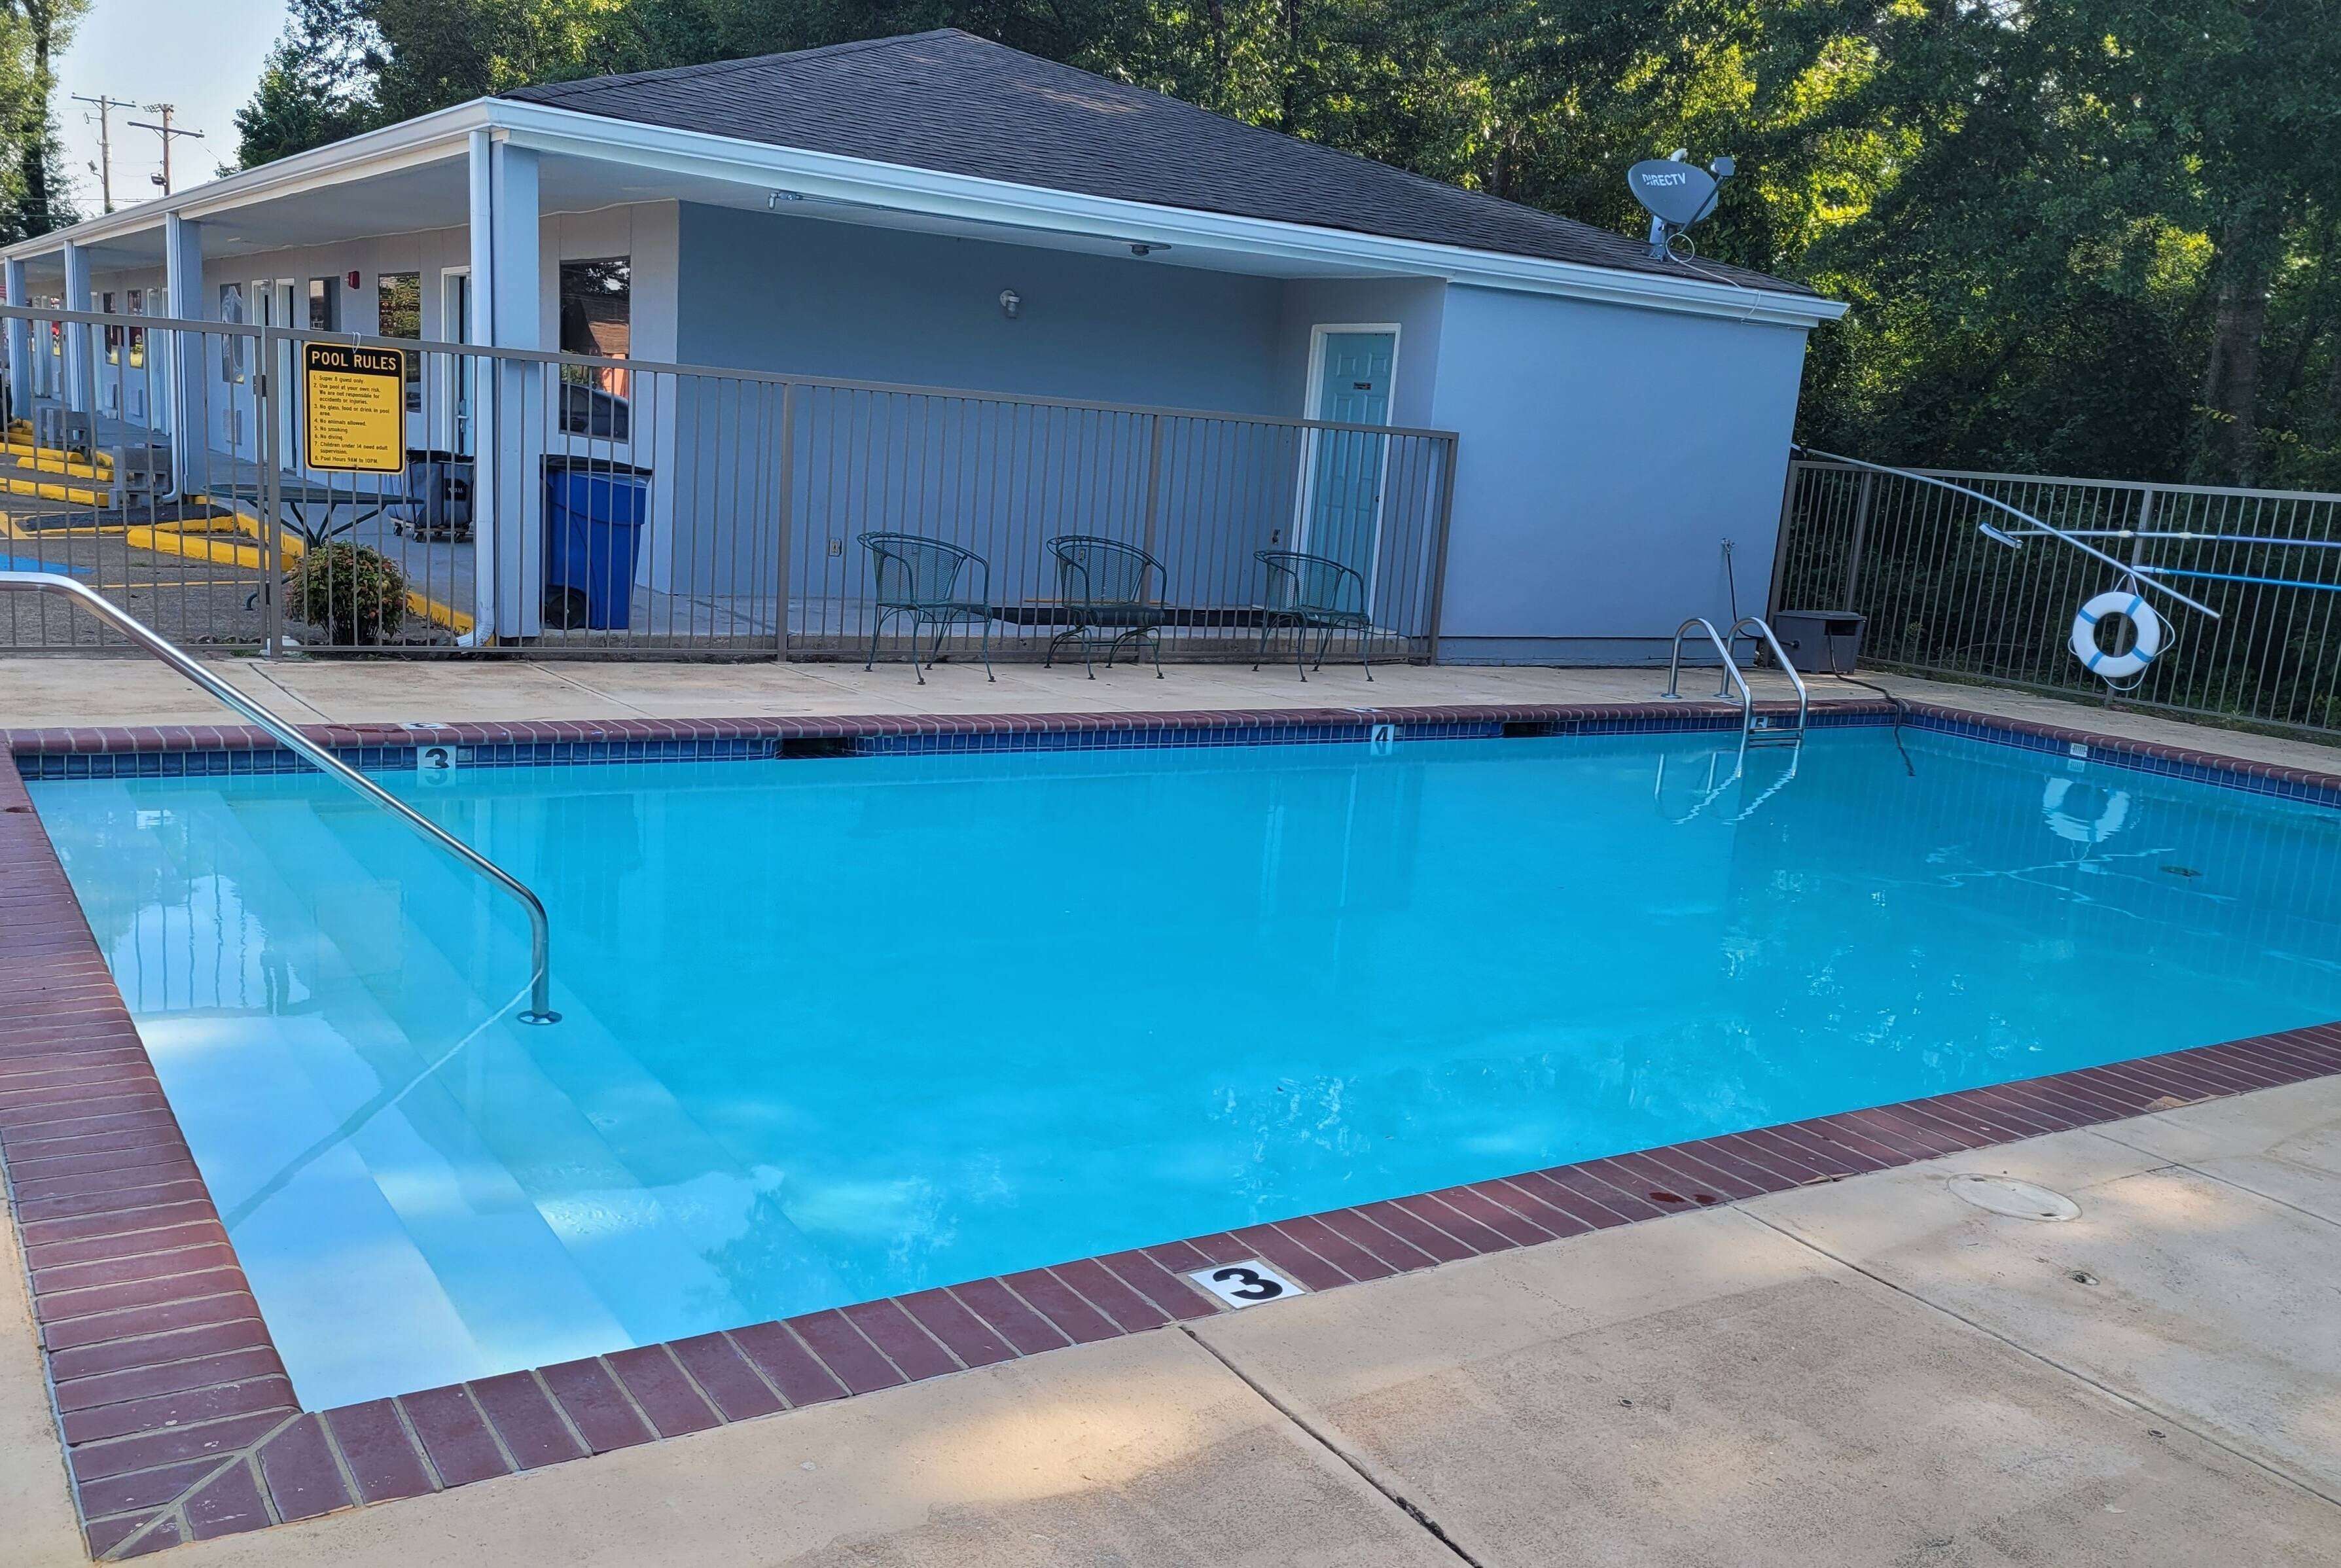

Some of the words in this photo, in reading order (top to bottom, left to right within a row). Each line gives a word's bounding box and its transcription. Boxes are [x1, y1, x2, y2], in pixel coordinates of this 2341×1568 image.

[1641, 172, 1686, 187] DIRECTV
[312, 350, 349, 367] POOL
[353, 354, 397, 371] RULES
[1375, 726, 1391, 742] 4
[424, 747, 450, 770] 3
[1212, 1268, 1283, 1300] 3
